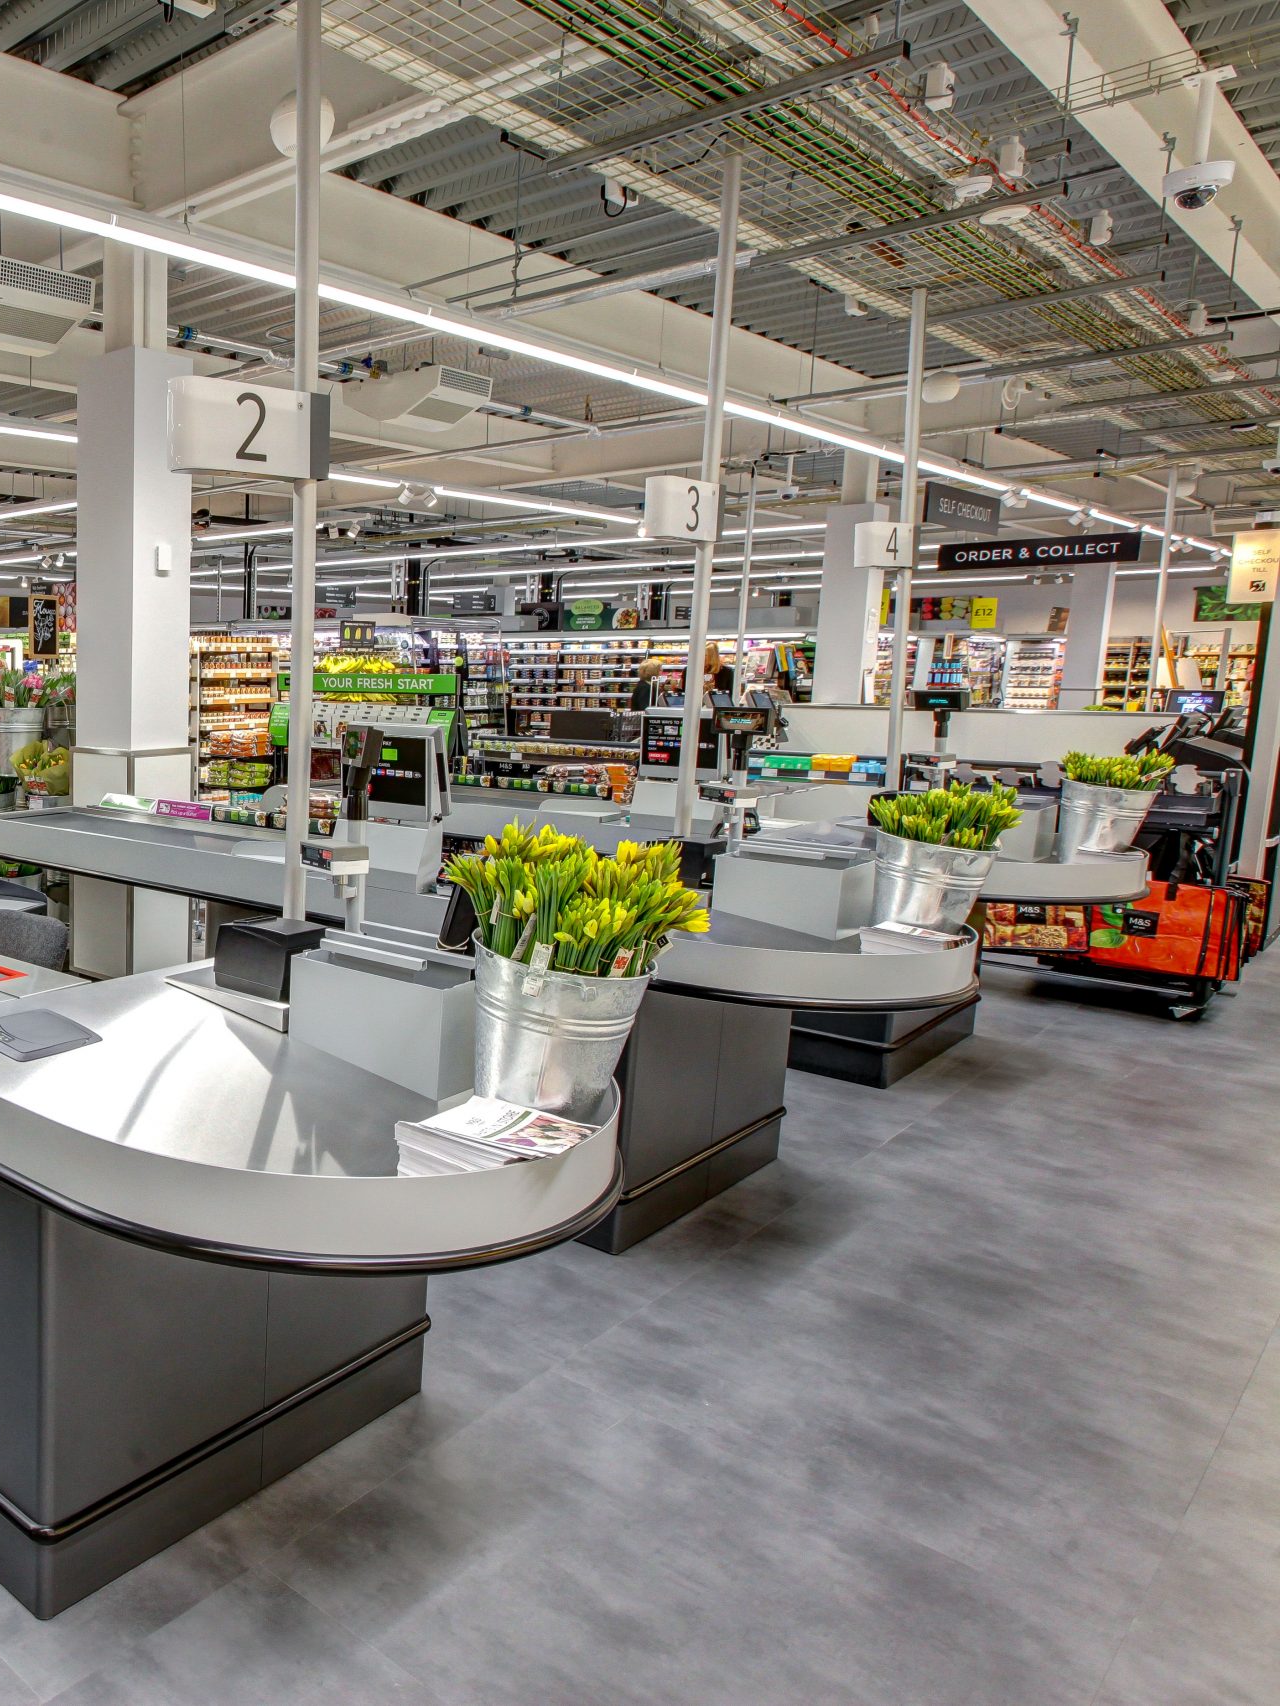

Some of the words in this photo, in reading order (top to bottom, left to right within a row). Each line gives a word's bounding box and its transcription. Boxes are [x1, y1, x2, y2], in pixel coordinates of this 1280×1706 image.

[236, 392, 267, 462] 2
[686, 486, 700, 532] 3
[938, 497, 957, 514] SELF
[957, 502, 992, 522] CHECKOUT
[886, 527, 899, 561] 4
[955, 548, 1013, 563] ORDER
[1018, 547, 1030, 559] &
[1036, 542, 1121, 558] COLLECT
[1238, 557, 1280, 565] CHECKOU
[974, 608, 993, 617] £12
[322, 677, 353, 689] YOUR
[357, 678, 393, 689] FRESH
[397, 678, 434, 690] START
[1019, 906, 1040, 914] M&S
[1129, 917, 1151, 927] M&S
